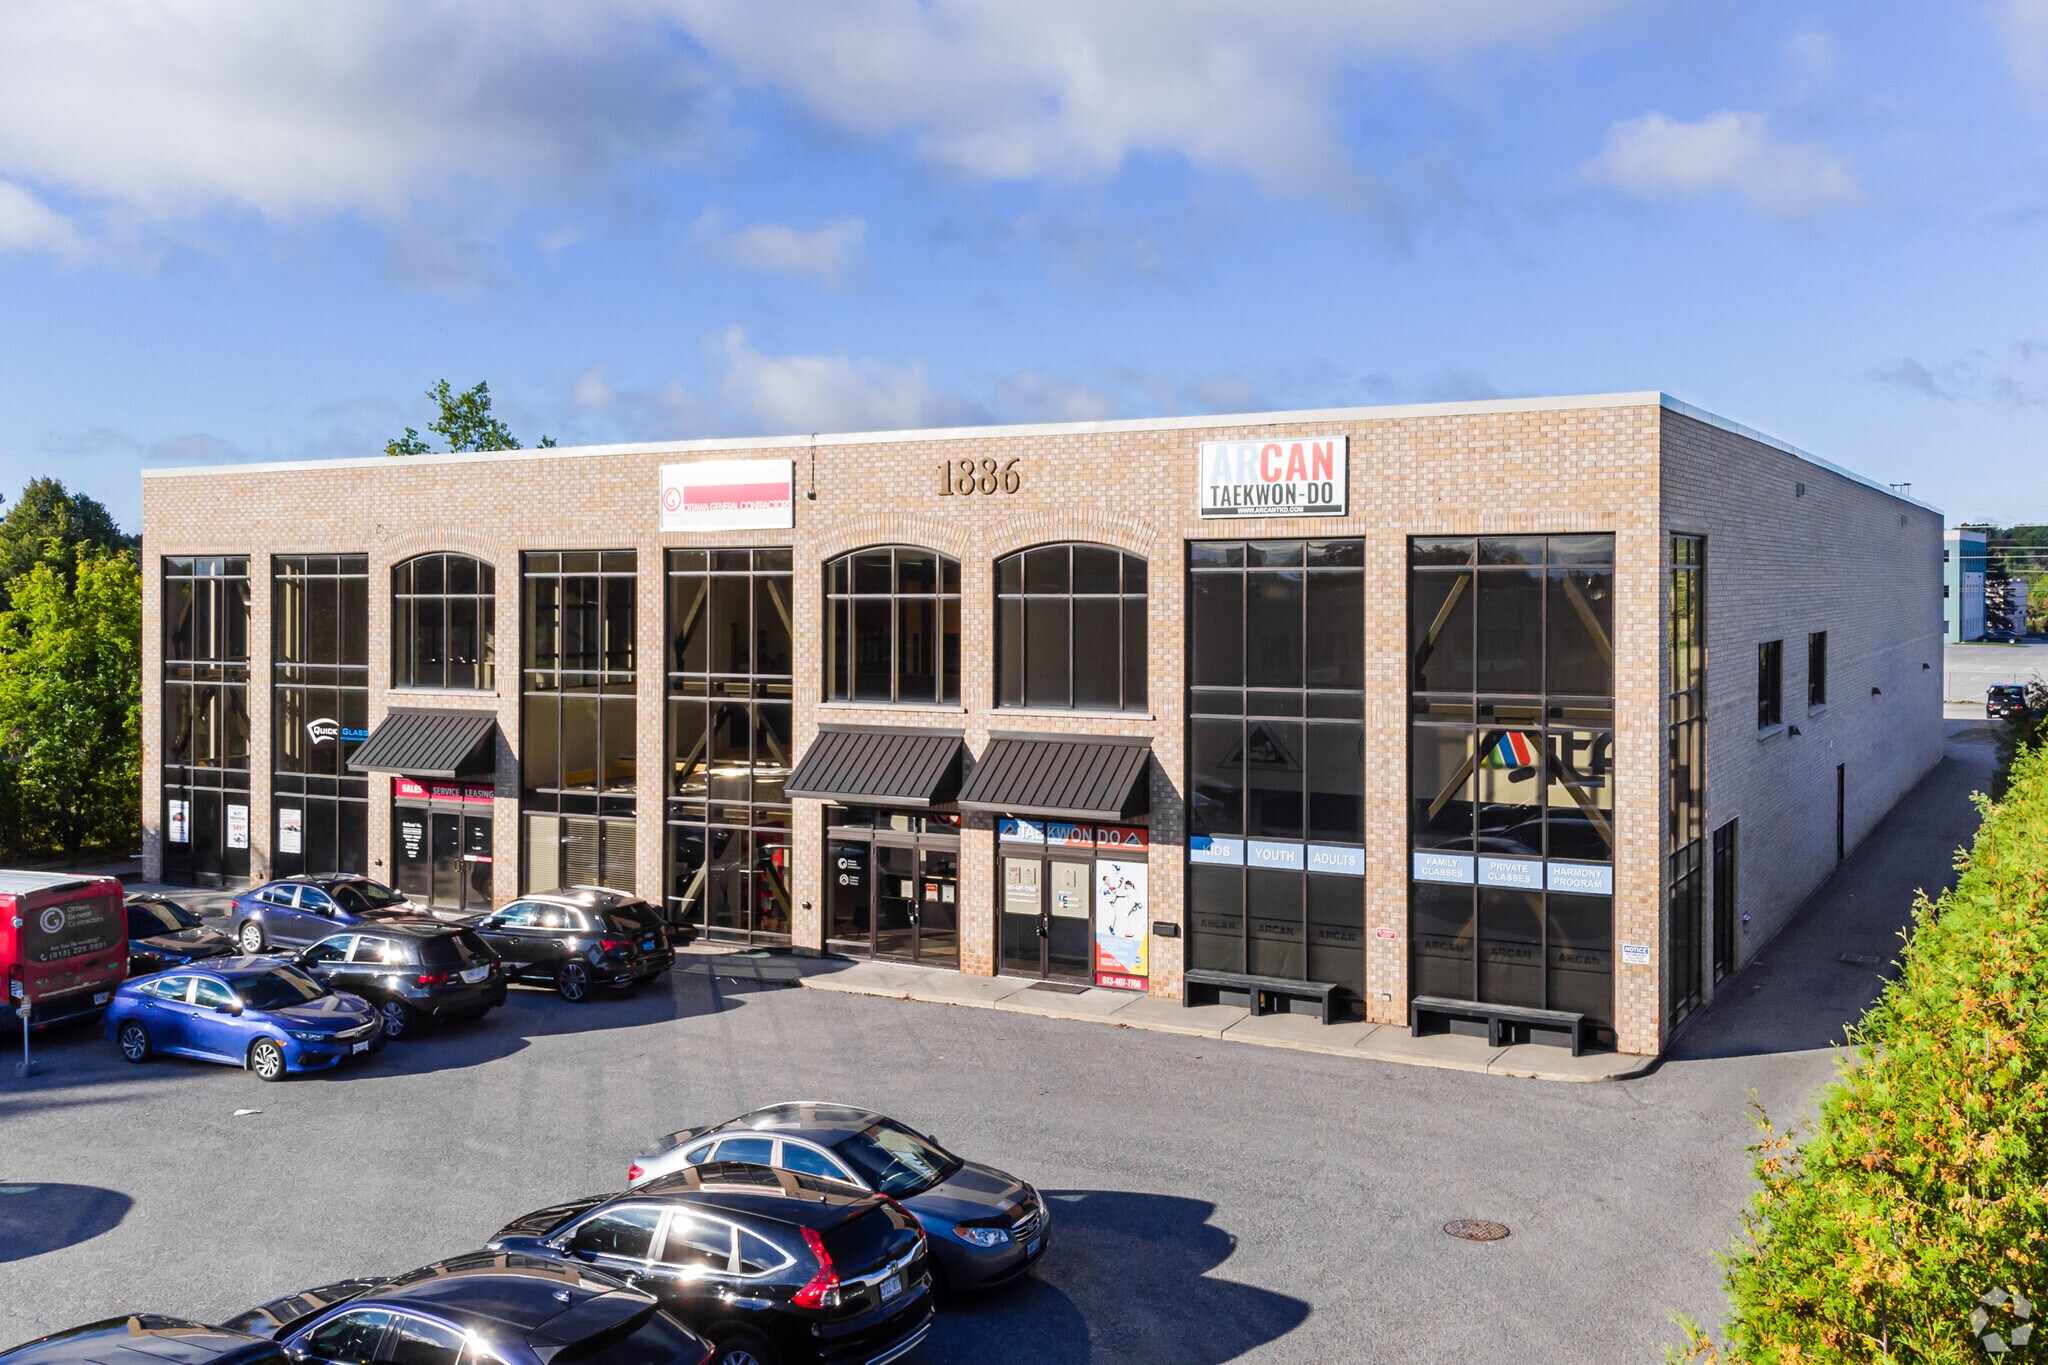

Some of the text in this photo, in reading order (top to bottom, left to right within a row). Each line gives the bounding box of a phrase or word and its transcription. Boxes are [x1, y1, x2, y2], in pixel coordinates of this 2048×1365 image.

[1211, 441, 1333, 484] ARCAN
[938, 458, 1020, 496] 1886
[1211, 482, 1333, 506] TAEKWON-DO
[740, 500, 791, 510] CONTRACTORS
[402, 784, 494, 798] SALES SERVICE LEASING
[1098, 829, 1121, 846] DO
[1202, 844, 1231, 857] KIDS
[1255, 848, 1296, 862] YOUTH
[1314, 853, 1356, 866] ADULTS
[1427, 857, 1459, 867] FAMILY
[1422, 868, 1464, 878] CLASSES
[1490, 862, 1529, 873] PRIVATE
[1553, 867, 1603, 878] HARMONY
[1488, 873, 1531, 884] CLASSES
[1553, 878, 1603, 889] PROGRAM
